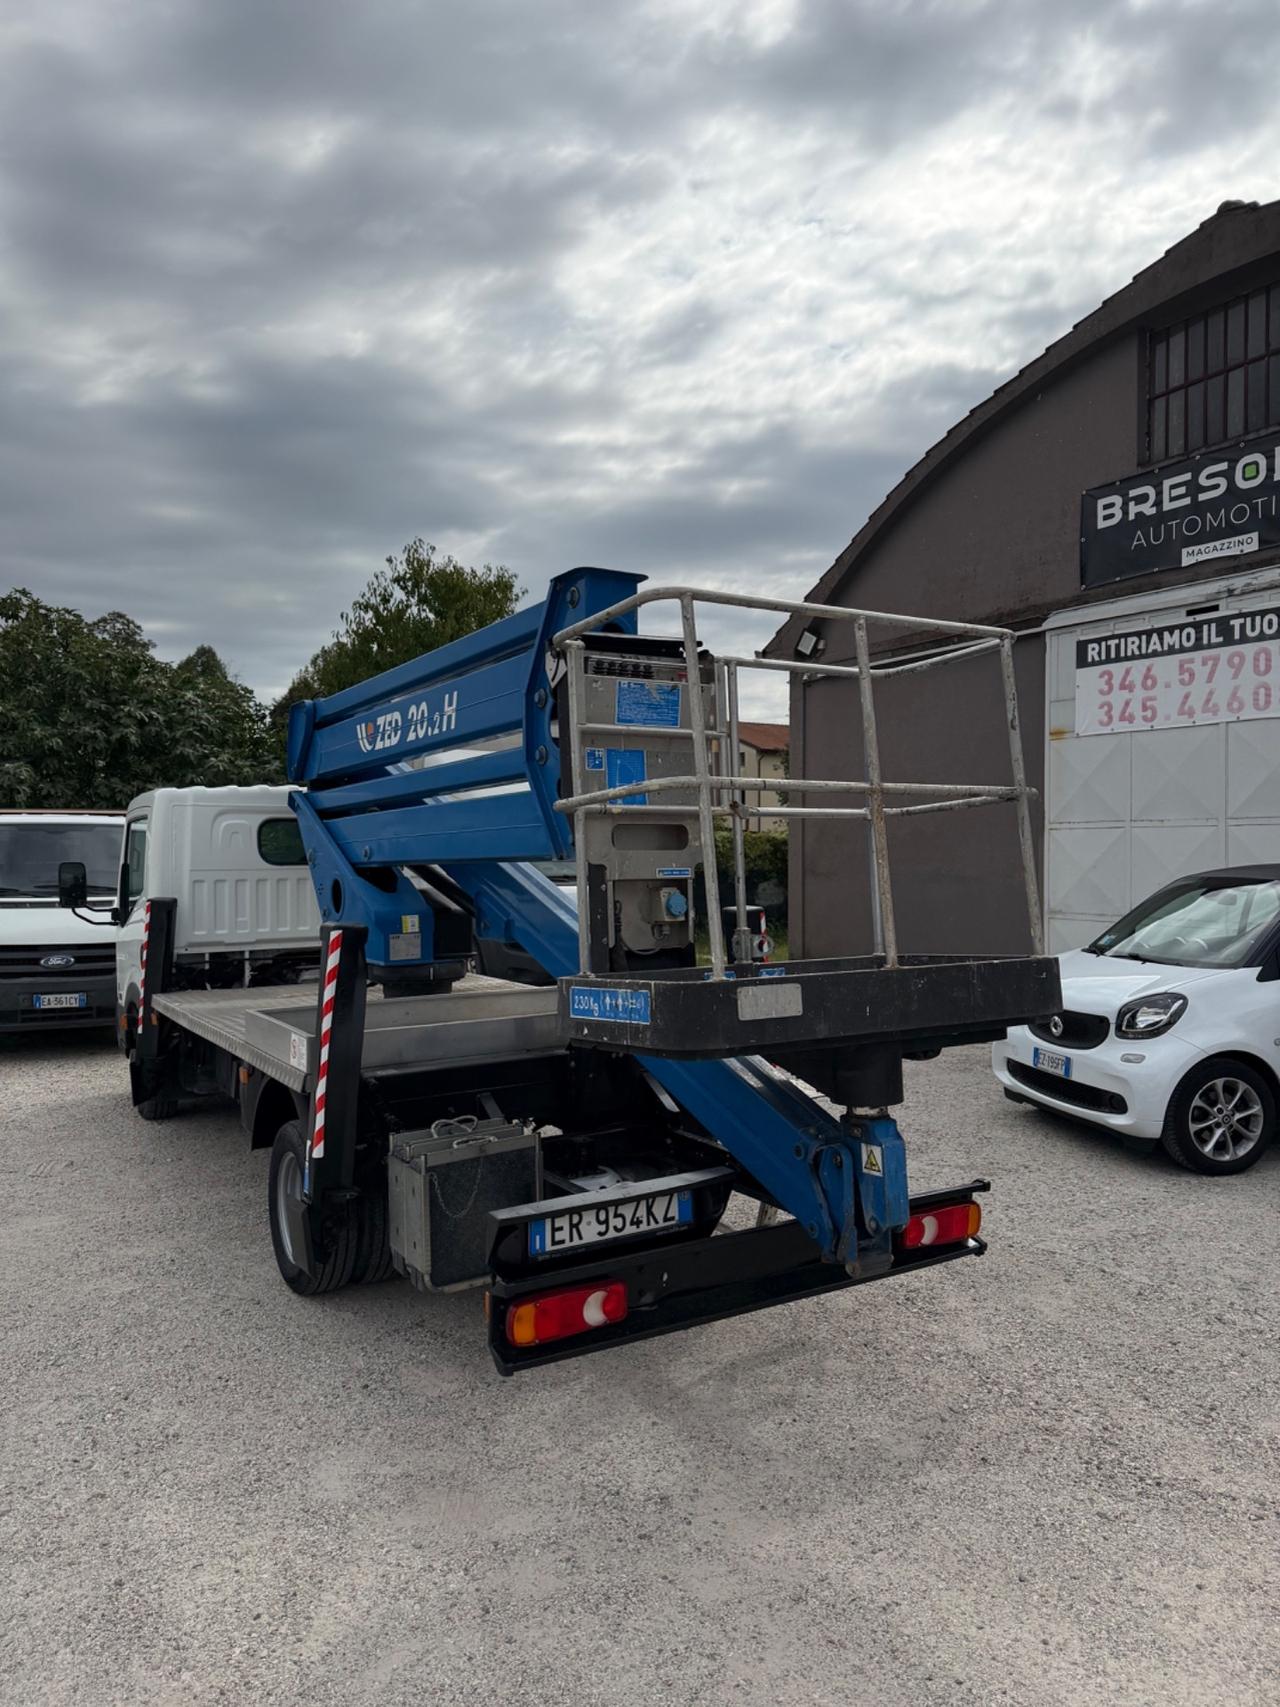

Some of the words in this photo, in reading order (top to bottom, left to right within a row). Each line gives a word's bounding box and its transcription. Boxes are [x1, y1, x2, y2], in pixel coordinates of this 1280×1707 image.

[1097, 446, 1280, 529] BRESO
[1131, 495, 1276, 550] AUTOMOTI
[1186, 536, 1254, 558] MAGAZZINO
[1087, 627, 1195, 663] RITIRIAMO
[1202, 623, 1223, 645] IL
[1229, 613, 1279, 640] TUO
[1097, 646, 1280, 696] 346.5790
[1097, 681, 1280, 727] 345.4460
[374, 711, 402, 751] ZED
